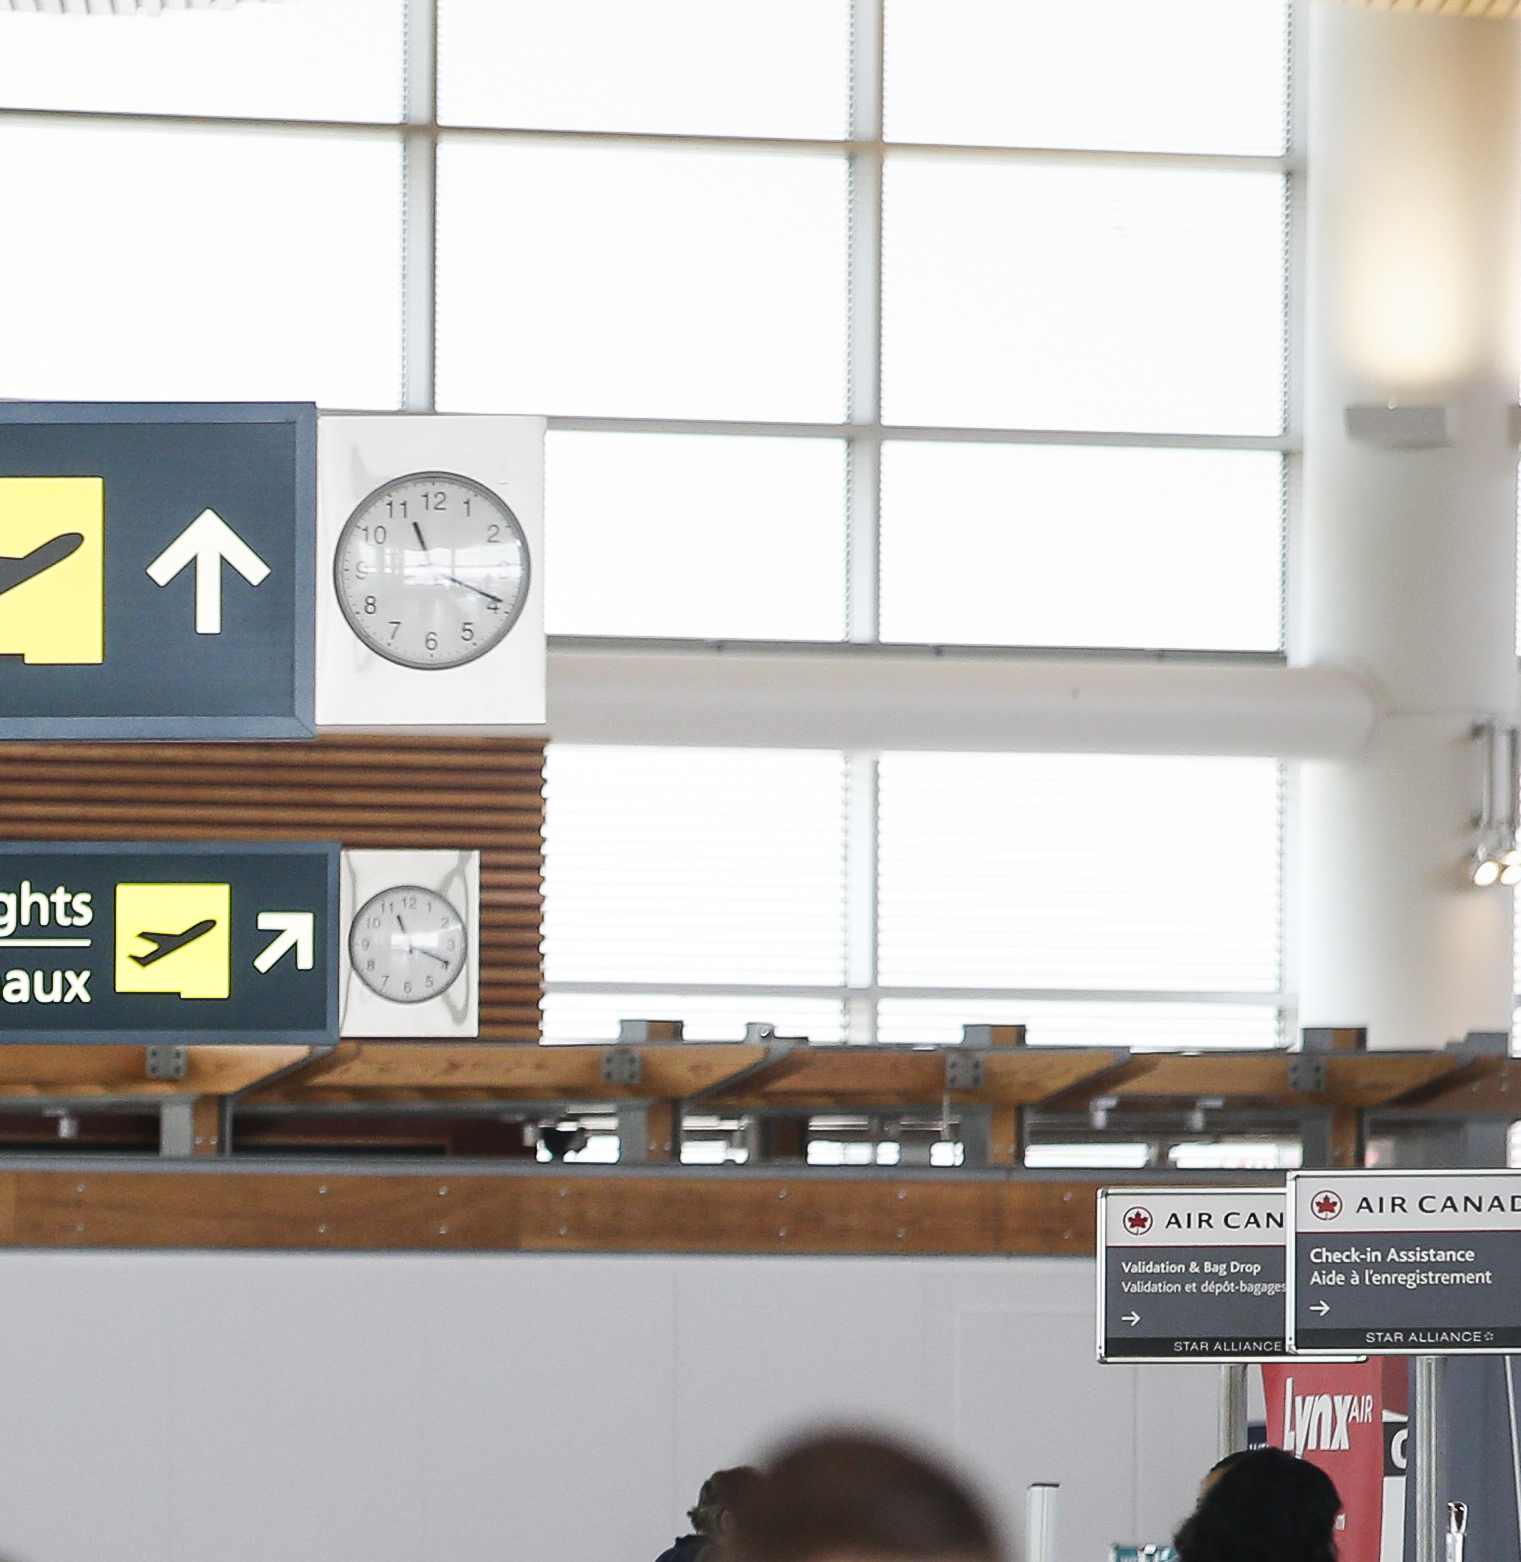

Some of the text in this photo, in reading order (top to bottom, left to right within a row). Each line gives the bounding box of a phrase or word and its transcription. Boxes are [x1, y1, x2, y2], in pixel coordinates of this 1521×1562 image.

[422, 491, 447, 511] 12
[463, 499, 471, 517] 1
[386, 501, 408, 519] 11
[363, 525, 386, 544] 10
[488, 525, 499, 543] 2
[364, 596, 376, 614] 8
[389, 621, 401, 640] 7
[461, 622, 474, 642] 5
[425, 632, 438, 651] 6
[381, 903, 394, 913] 11
[402, 897, 417, 909] 12
[427, 902, 432, 913] 1
[367, 917, 381, 928] 10
[367, 960, 375, 971] 8
[382, 975, 390, 987] 7
[404, 982, 412, 994] 6
[425, 976, 433, 987] 5
[1356, 1195, 1521, 1213] AIR CANAD
[1166, 1212, 1284, 1229] AIR CAN
[1309, 1247, 1475, 1262] Check-in Assistance
[1121, 1261, 1261, 1276] Validation & Bag Drop
[1310, 1270, 1345, 1285] Aide
[1350, 1271, 1359, 1285] à
[1121, 1280, 1286, 1296] Validation et dépôt-bagages
[1366, 1331, 1481, 1343] STAR ALLIANCE
[1174, 1341, 1282, 1351] STAR ALLIANCE
[1283, 1377, 1350, 1459] Lynx
[1348, 1395, 1373, 1423] AIR
